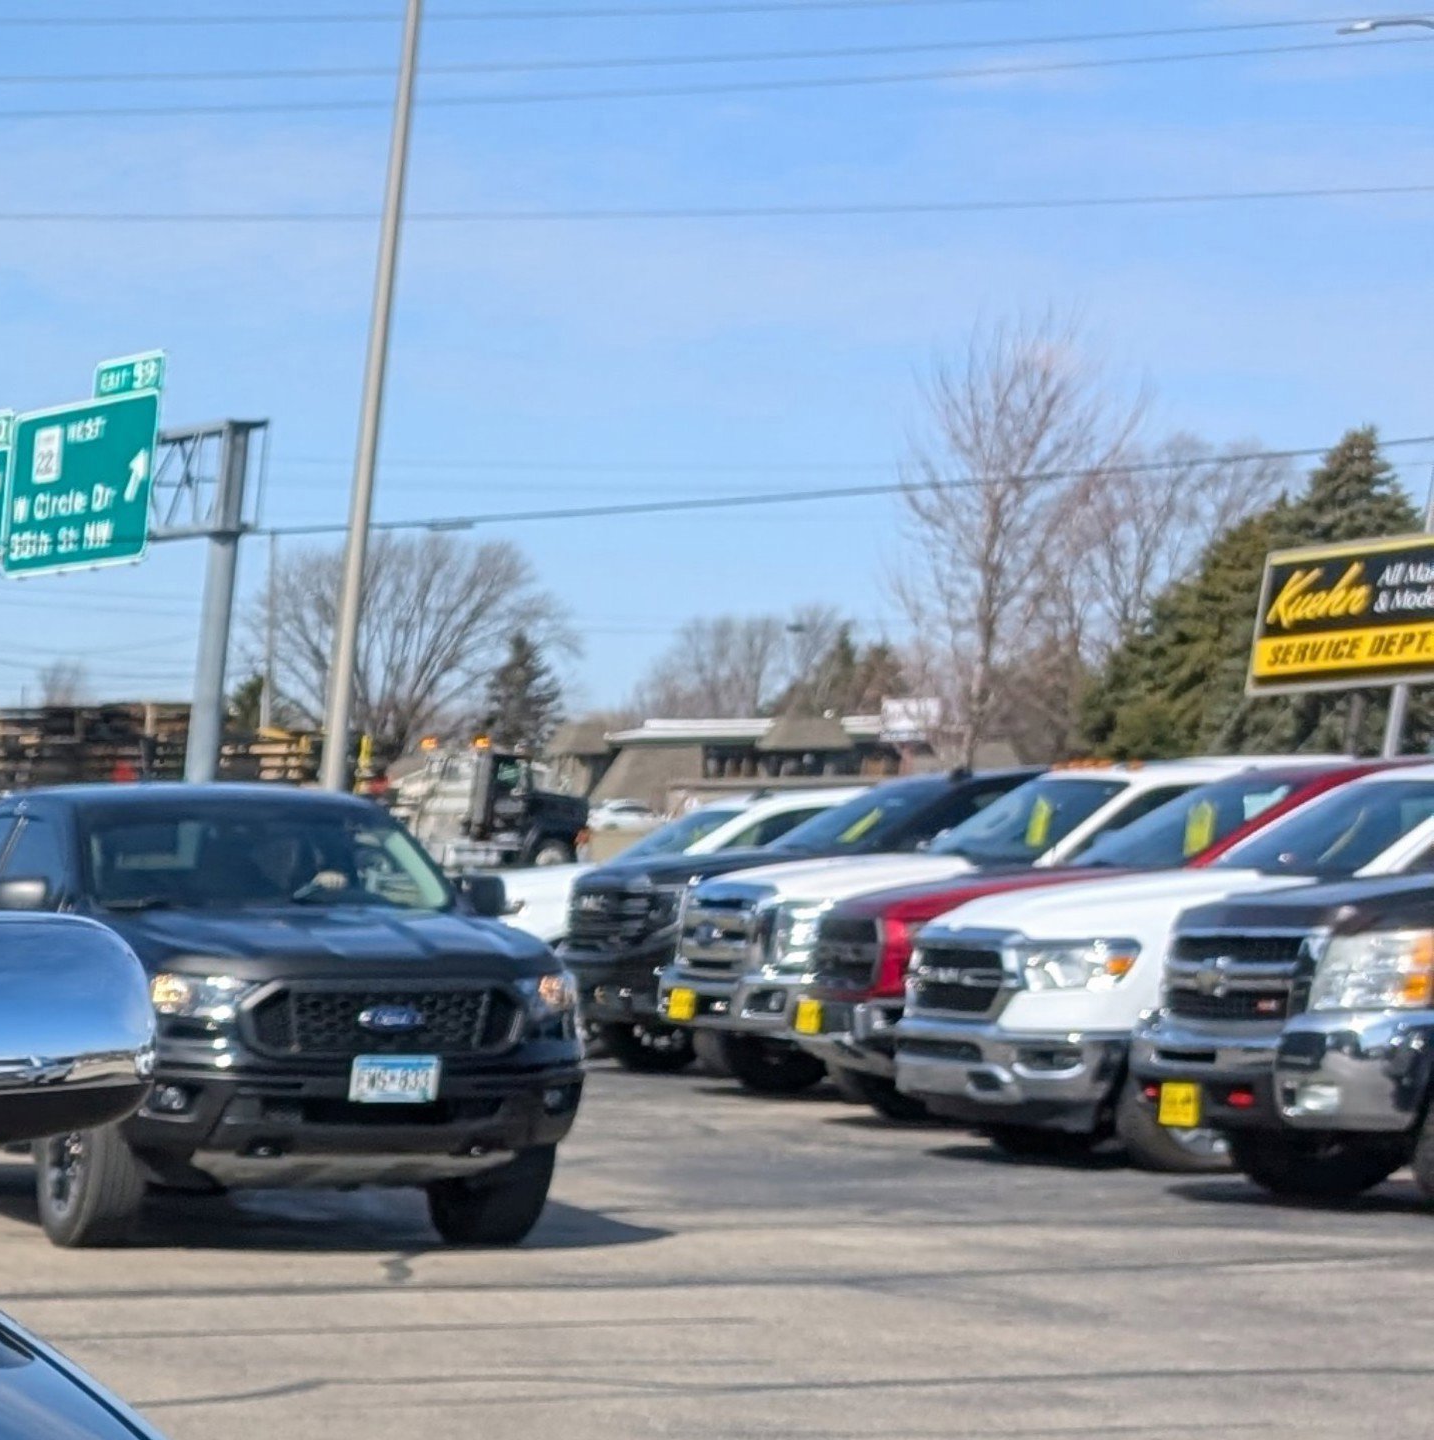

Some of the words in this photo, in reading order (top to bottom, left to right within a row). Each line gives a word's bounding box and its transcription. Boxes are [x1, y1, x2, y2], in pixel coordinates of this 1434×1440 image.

[35, 450, 54, 476] 22
[34, 490, 88, 521] Circle
[91, 483, 117, 512] Dr
[1377, 562, 1406, 588] All
[1266, 561, 1373, 629] Kuehn
[1267, 636, 1363, 668] SERVICE
